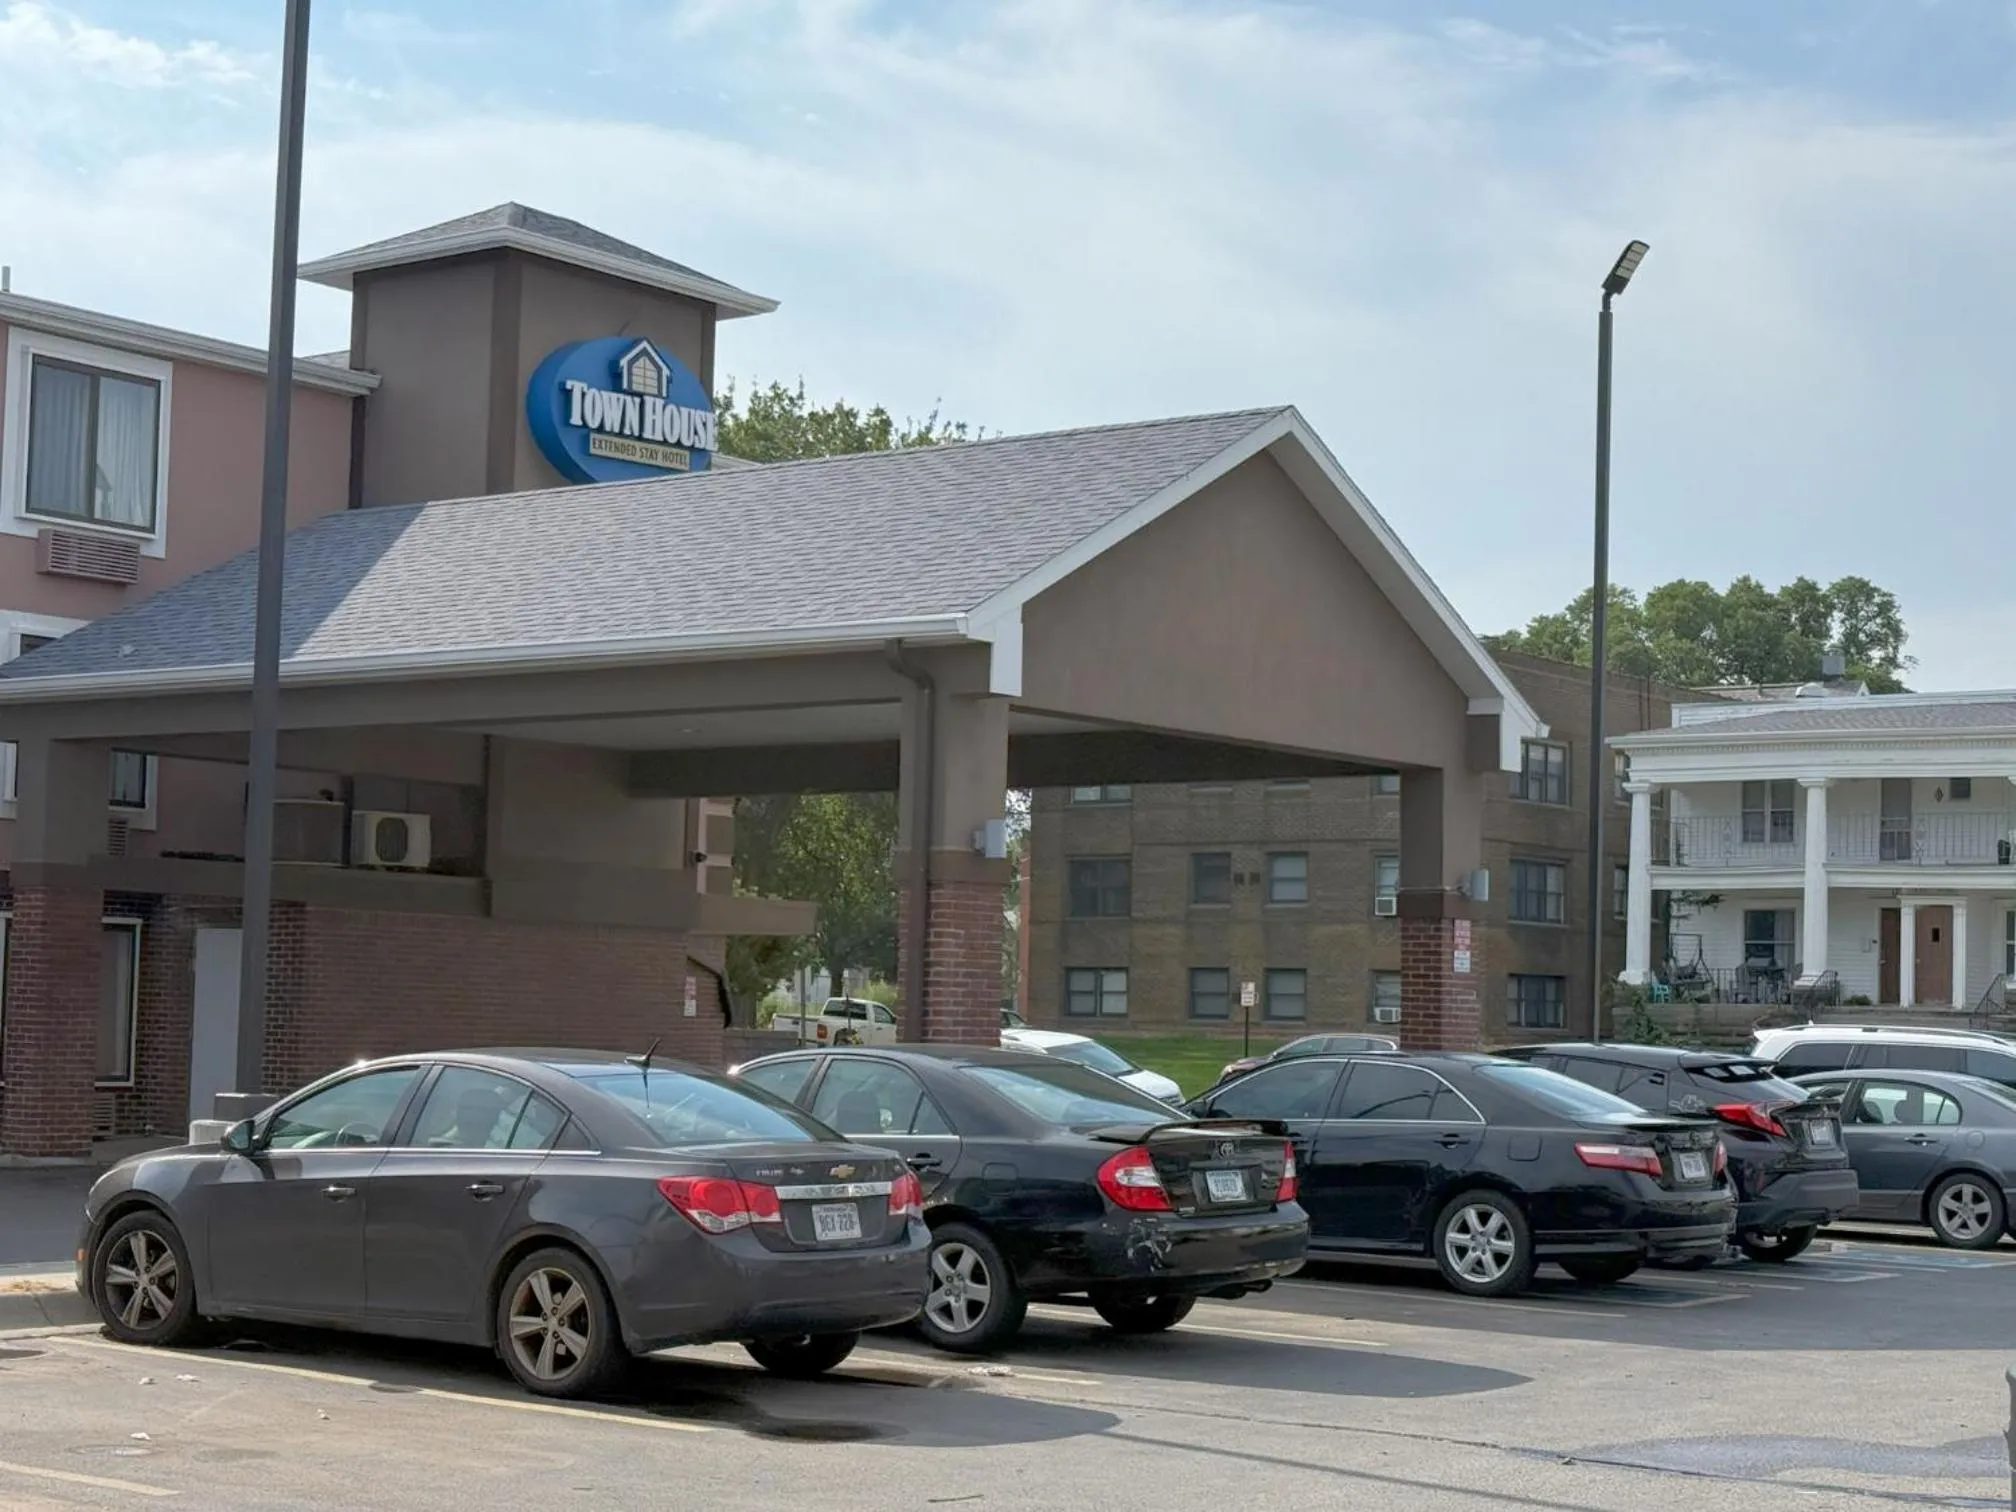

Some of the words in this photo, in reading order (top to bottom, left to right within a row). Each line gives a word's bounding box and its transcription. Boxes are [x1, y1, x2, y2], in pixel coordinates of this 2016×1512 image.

[565, 380, 641, 436] TOWN
[642, 394, 719, 452] HOUSE
[591, 436, 638, 458] EXTENDED
[639, 444, 661, 462] STAY
[661, 450, 689, 467] HOTEL
